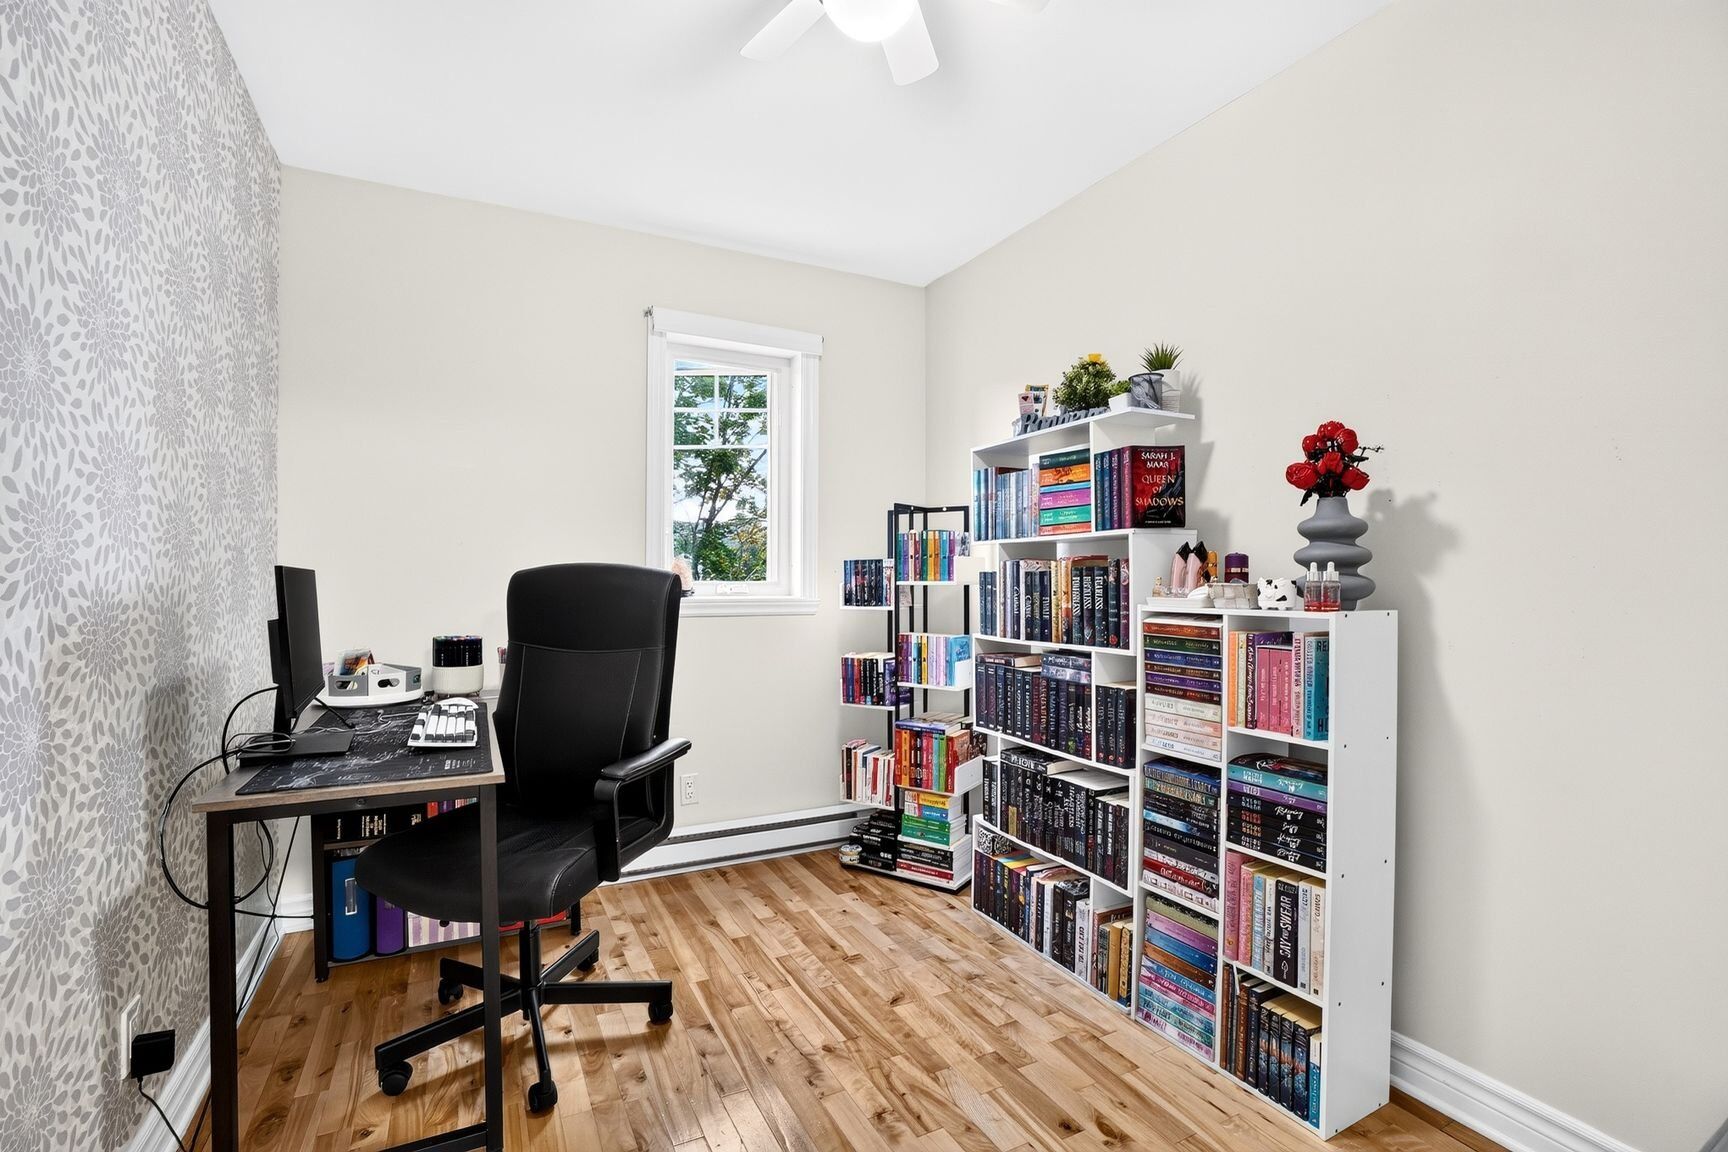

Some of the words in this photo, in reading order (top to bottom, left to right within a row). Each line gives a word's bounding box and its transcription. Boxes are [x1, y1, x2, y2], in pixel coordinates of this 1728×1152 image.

[1141, 452, 1168, 460] SARAH
[1141, 474, 1176, 485] QUEEN
[1135, 496, 1184, 506] SHADOWS
[1280, 896, 1292, 930] SWEAR
[1280, 938, 1292, 958] SAY
